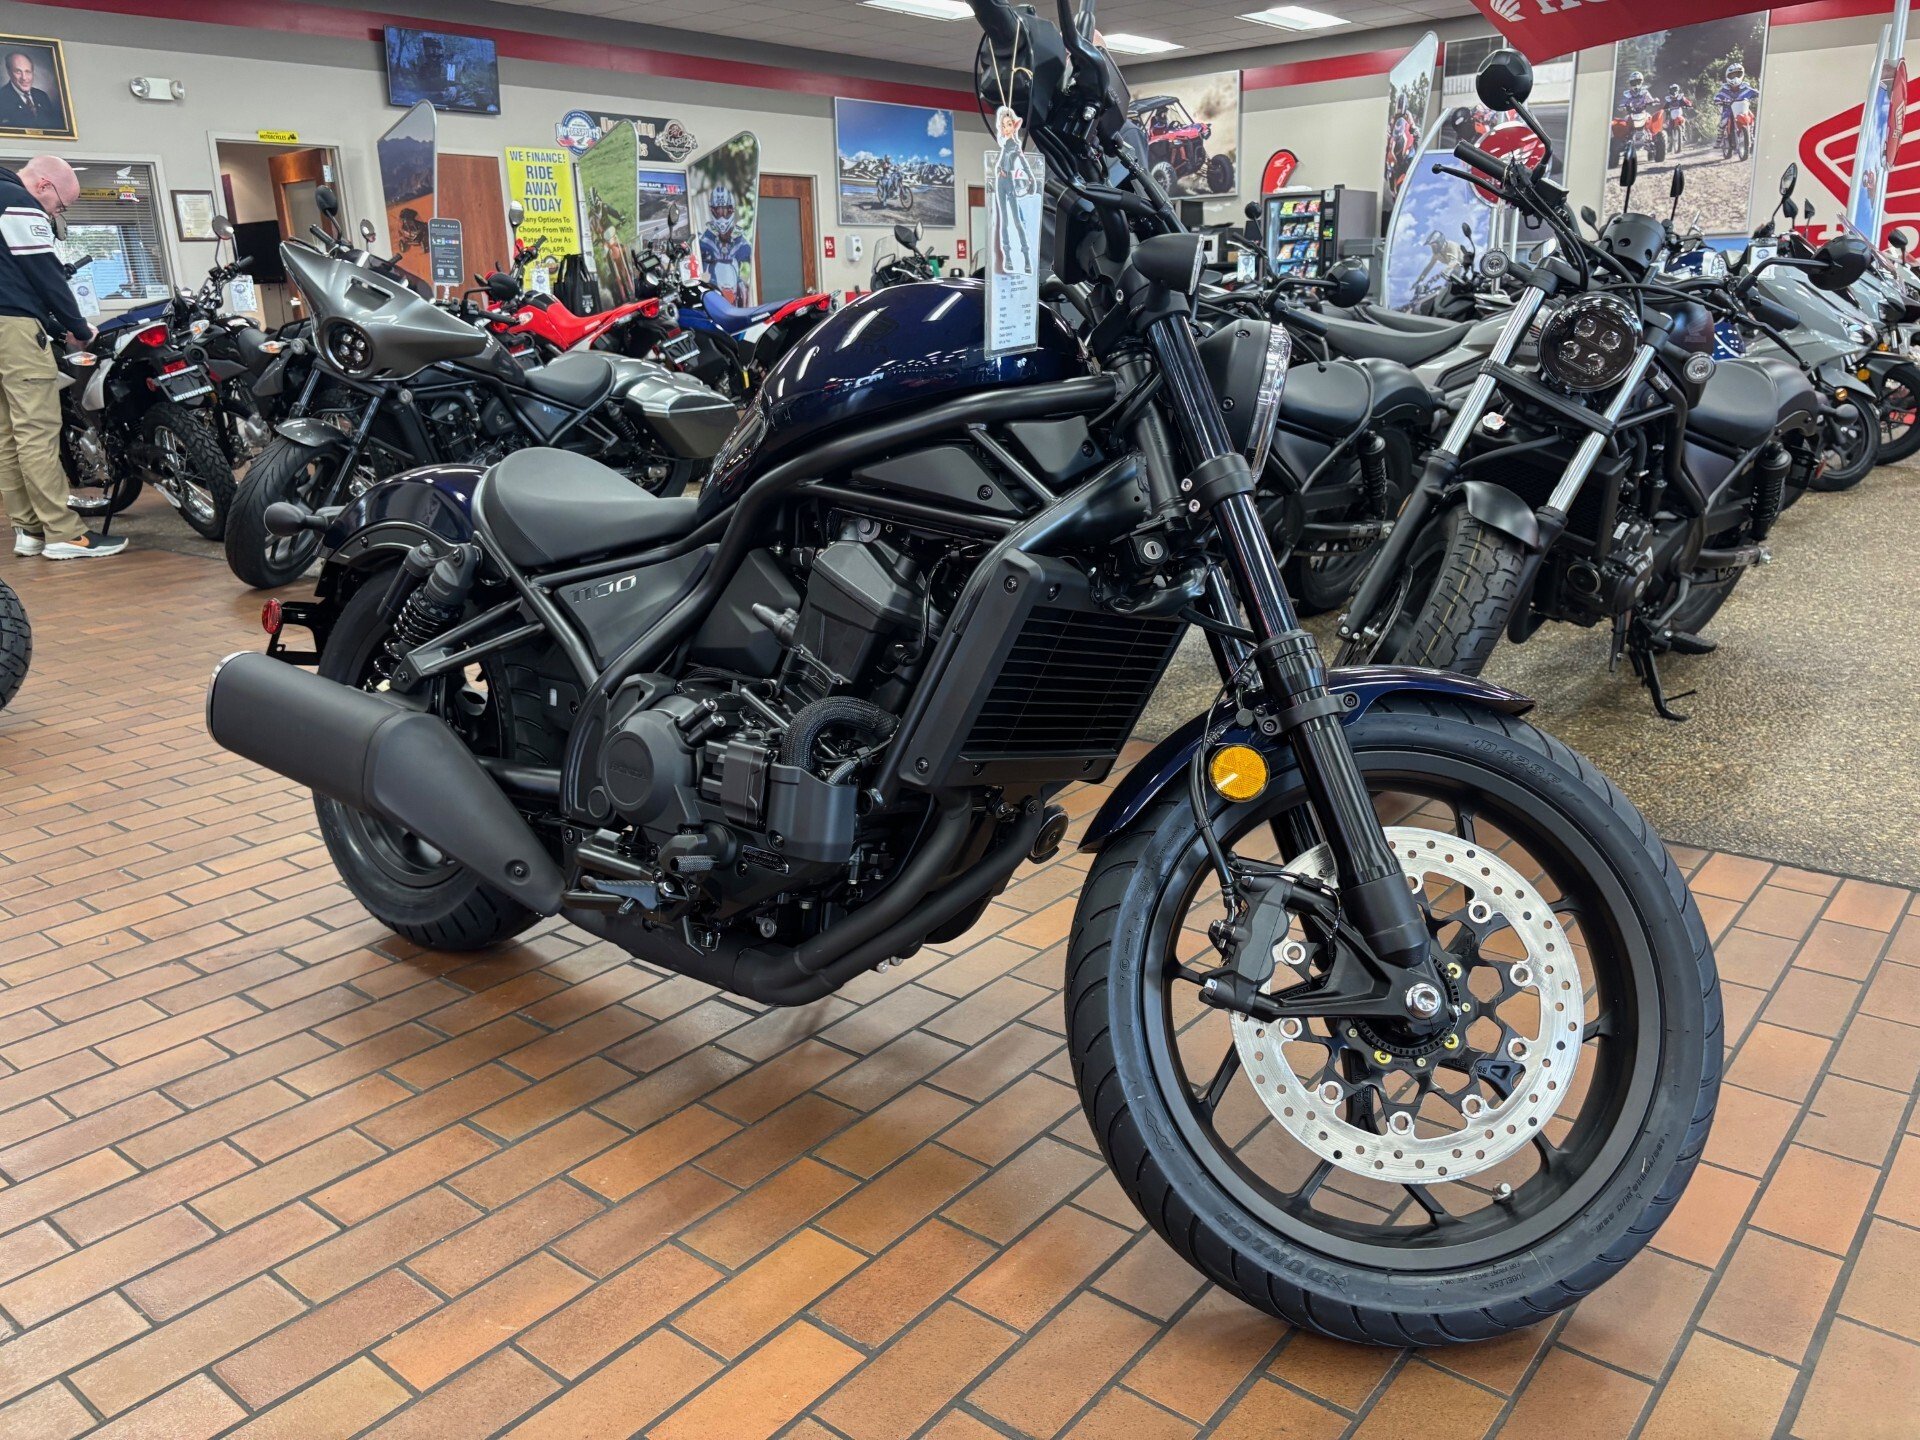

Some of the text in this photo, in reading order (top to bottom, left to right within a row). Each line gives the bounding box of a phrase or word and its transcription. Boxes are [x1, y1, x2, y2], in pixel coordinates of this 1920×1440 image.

[556, 123, 601, 140] MOTORSPORTS
[509, 151, 566, 163] WE FINANCE!
[526, 165, 553, 180] RIDE
[525, 182, 557, 196] AWAY
[524, 198, 561, 212] TODAY
[538, 216, 562, 224] Options
[570, 575, 636, 603] 1100
[1214, 1212, 1335, 1288] DUNLOP
[1489, 1272, 1526, 1289] TUBELESS
